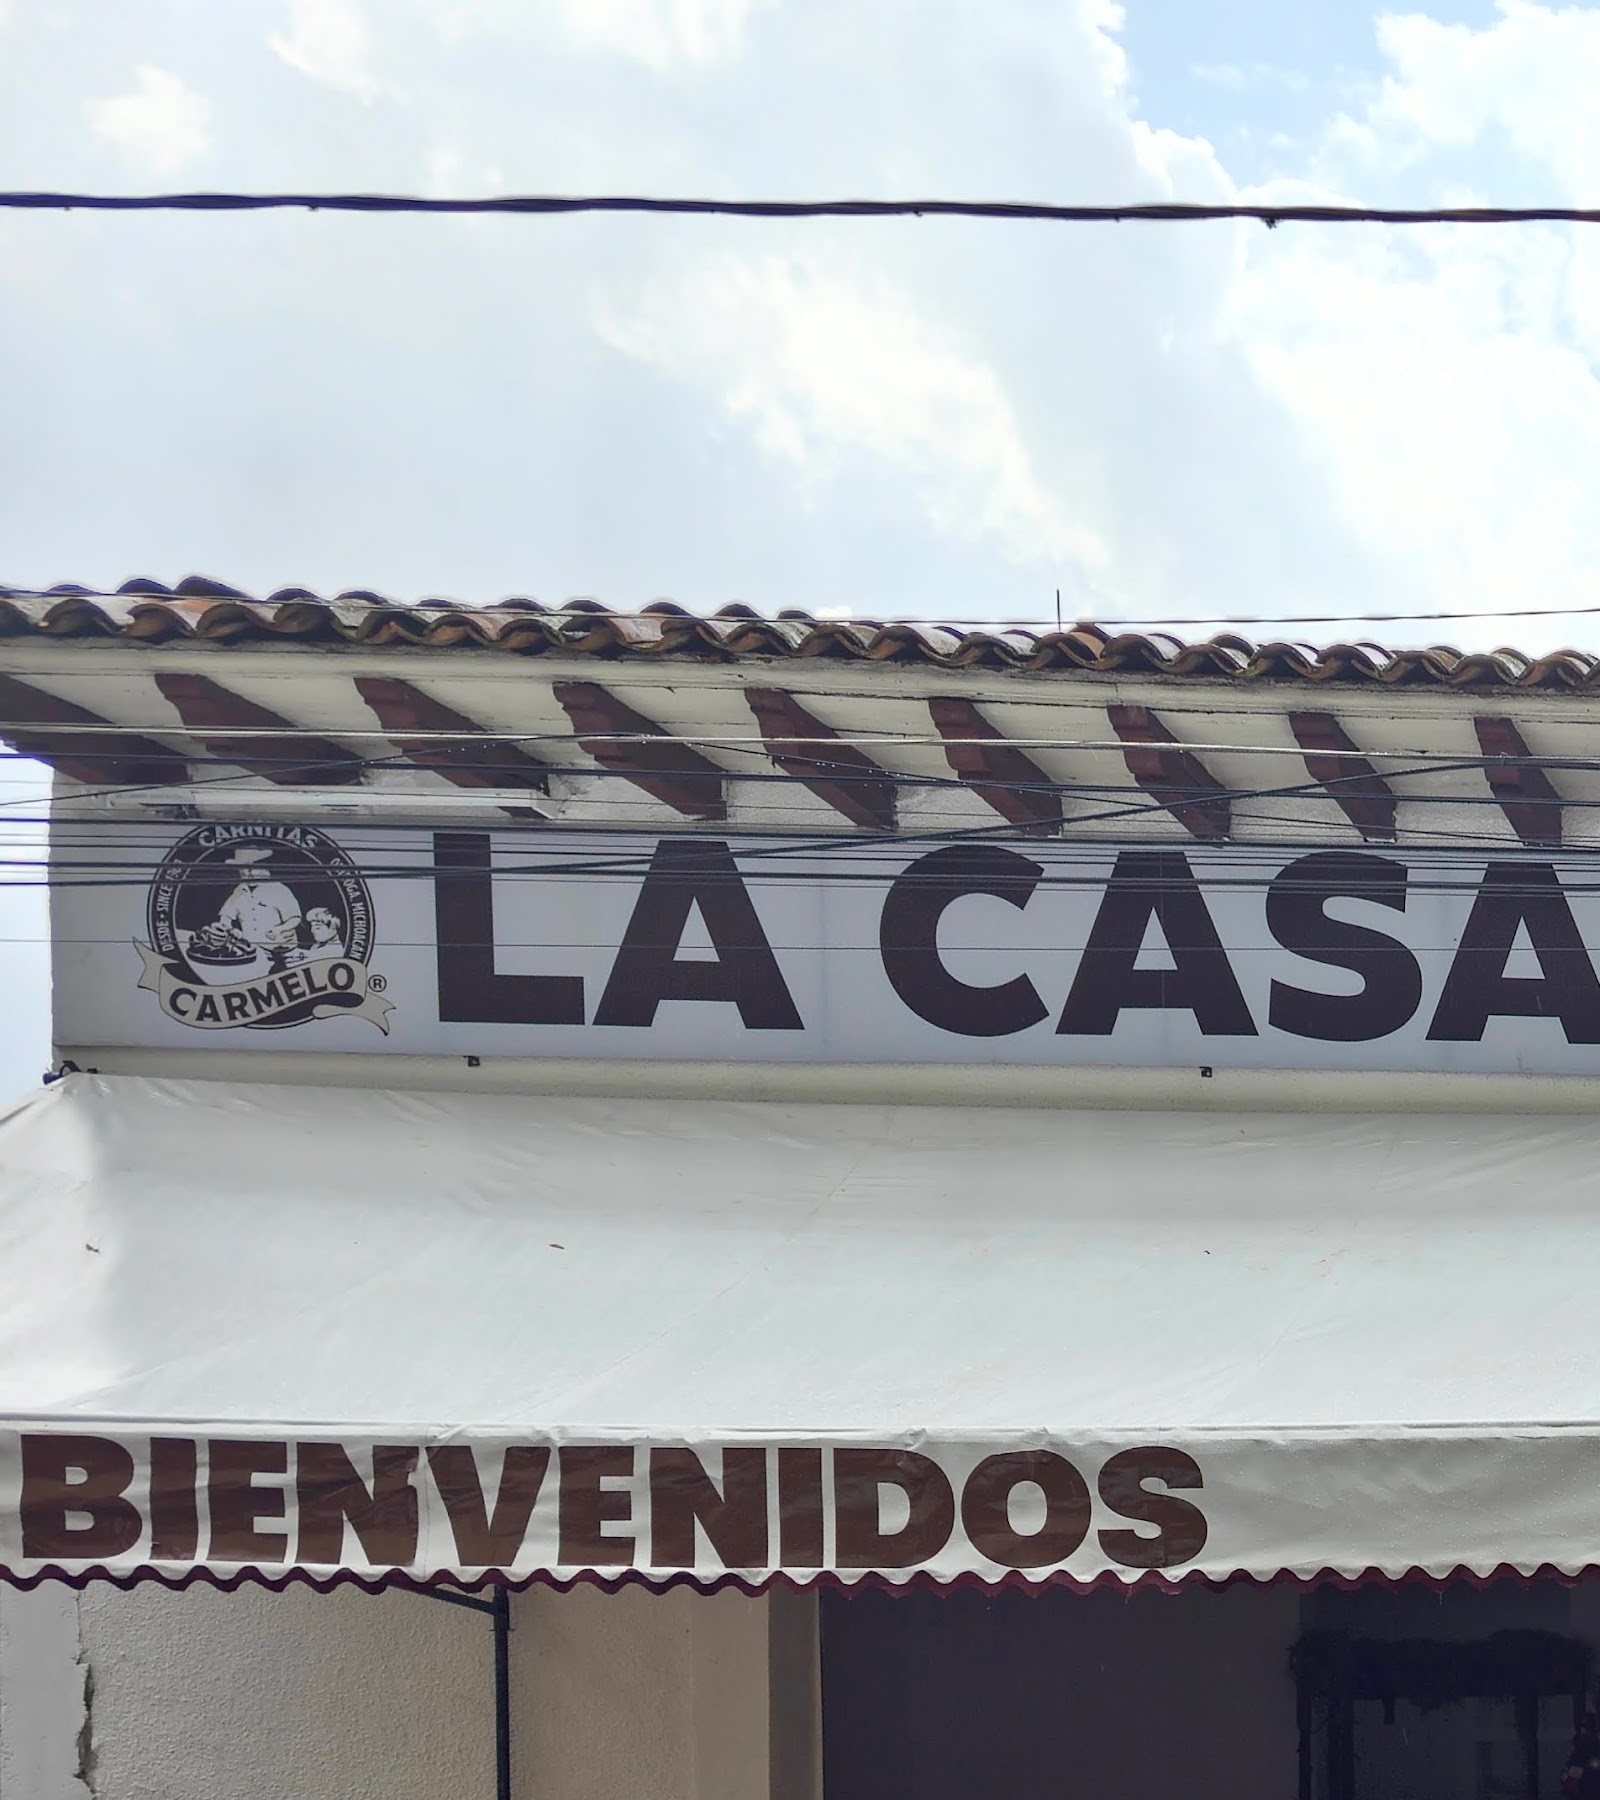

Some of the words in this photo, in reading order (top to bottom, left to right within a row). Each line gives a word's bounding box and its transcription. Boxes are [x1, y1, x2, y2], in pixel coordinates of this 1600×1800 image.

[156, 882, 173, 912] SINCE
[156, 919, 175, 952] DESDE
[348, 902, 367, 960] MICHOACAN
[434, 834, 804, 1030] LA
[169, 962, 356, 1023] CARMELO
[19, 1433, 1209, 1569] BIENVENIDOS
